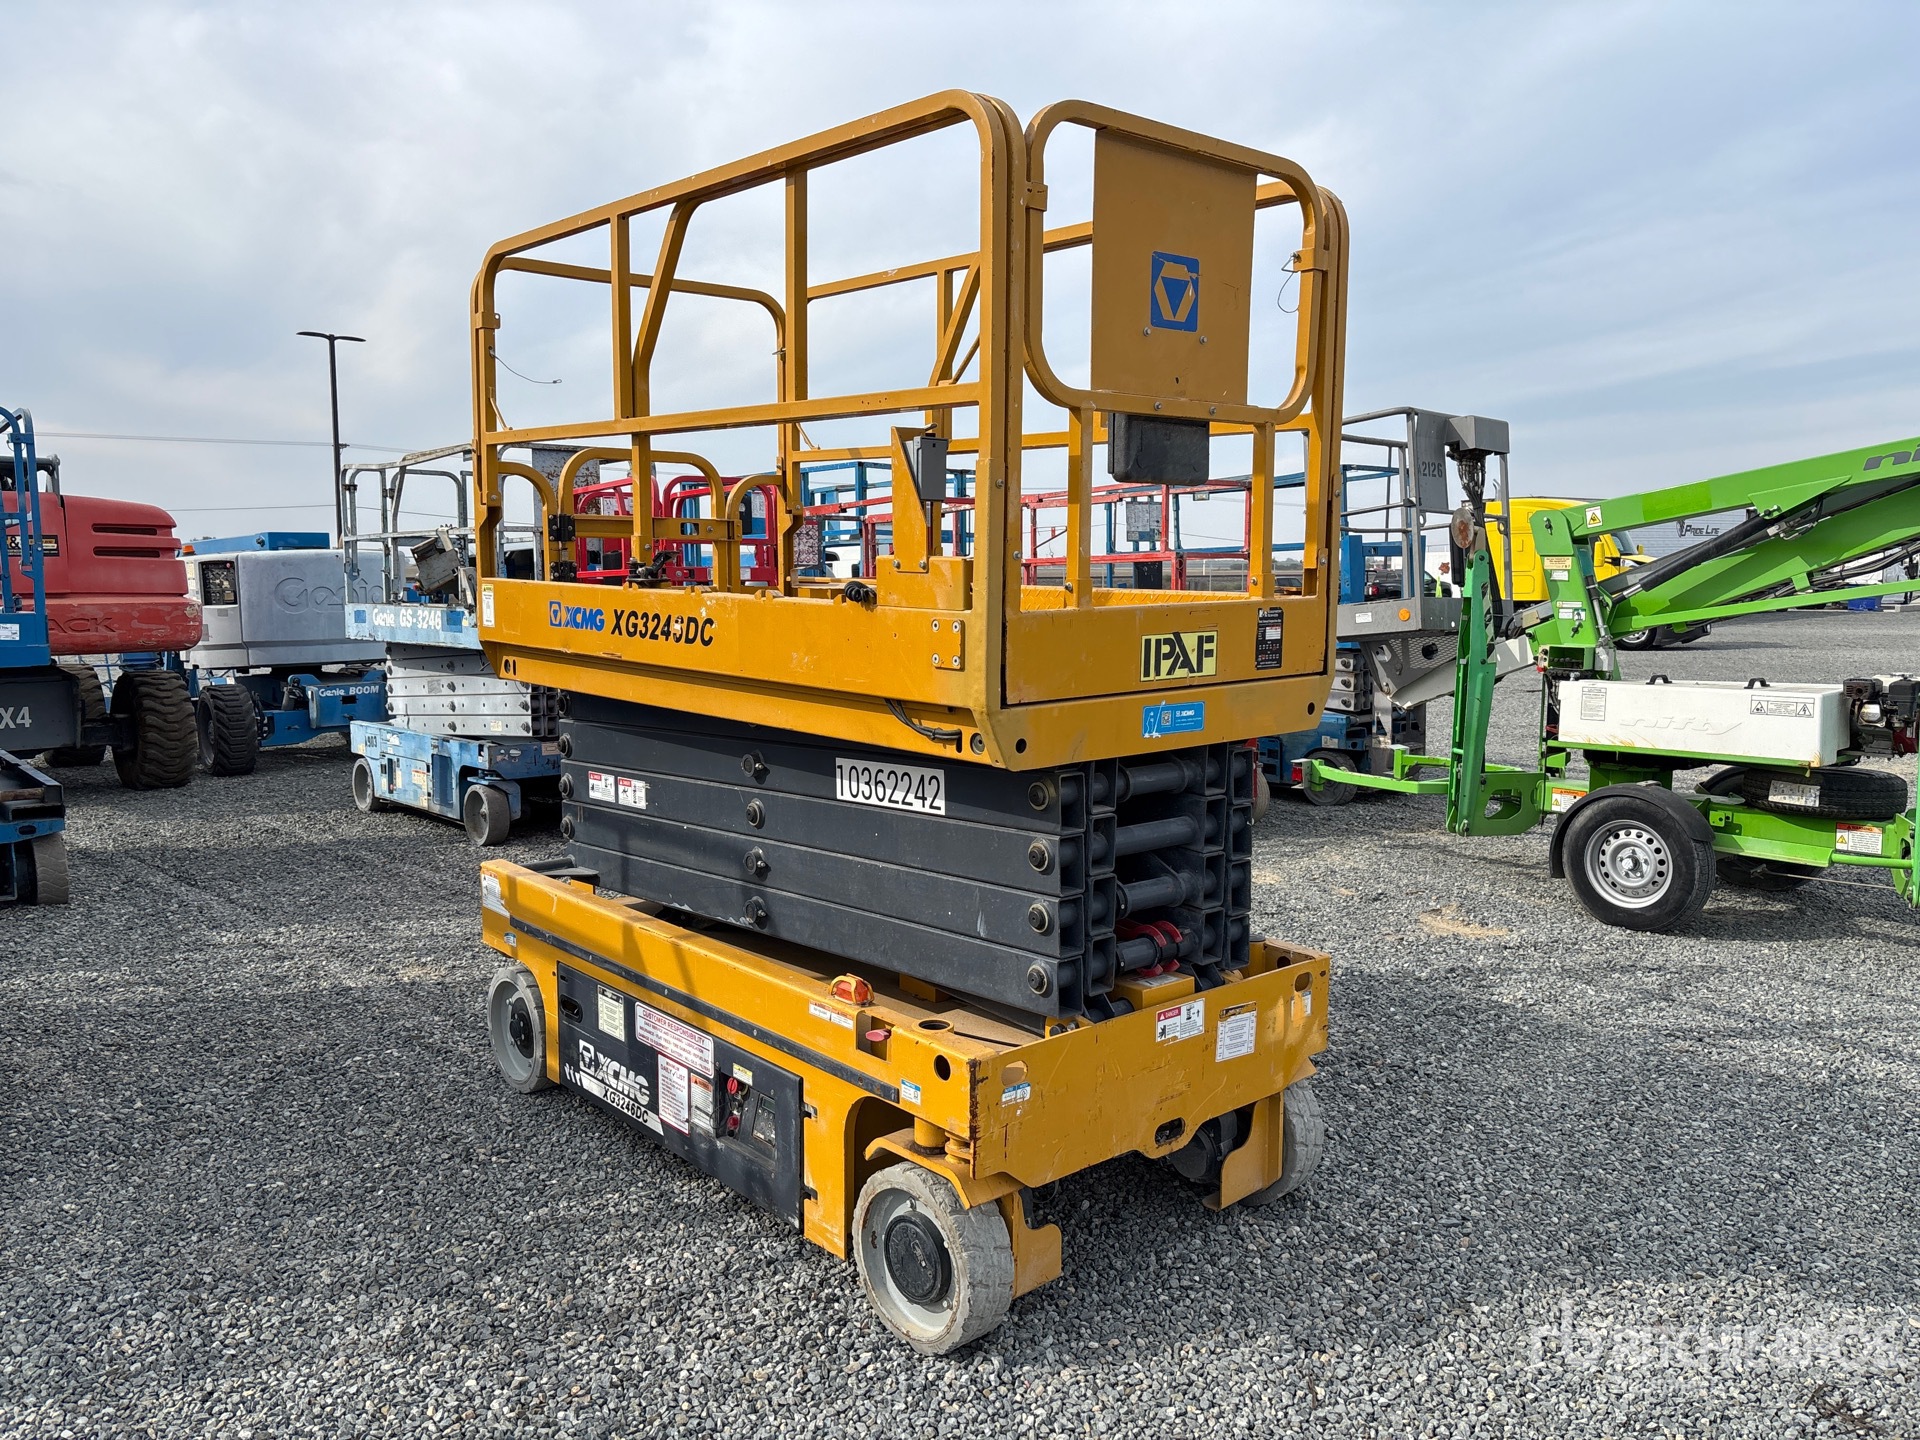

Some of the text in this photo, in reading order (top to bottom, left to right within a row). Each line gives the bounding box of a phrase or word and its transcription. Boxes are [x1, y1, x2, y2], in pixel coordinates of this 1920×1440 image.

[372, 608, 442, 630] Genie GS-3246
[564, 605, 606, 632] XCMG
[1143, 631, 1215, 678] IPAF
[319, 685, 380, 697] Genie BOOM
[836, 764, 942, 811] 10362242
[642, 1009, 705, 1045] CUSTOMER RESPONSIBILITY
[595, 1051, 650, 1106] XCMG
[602, 1086, 649, 1124] XG3246DC
